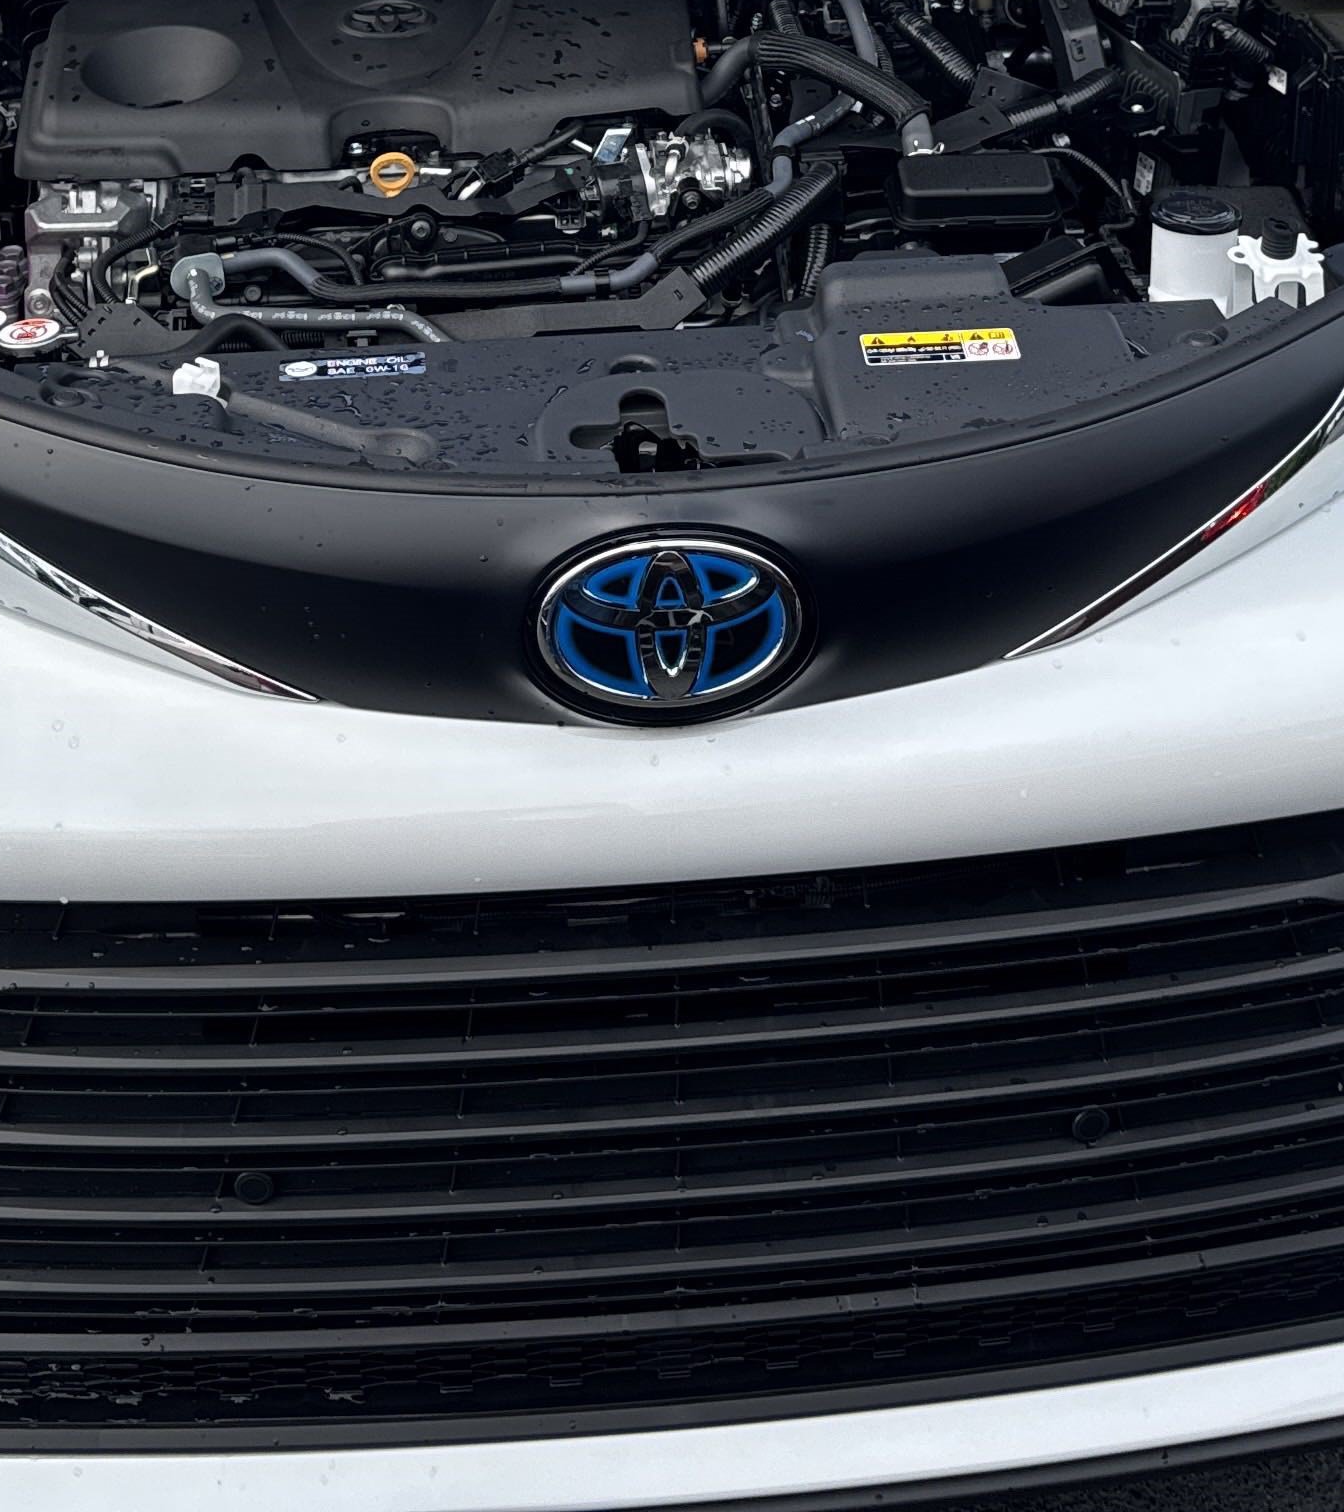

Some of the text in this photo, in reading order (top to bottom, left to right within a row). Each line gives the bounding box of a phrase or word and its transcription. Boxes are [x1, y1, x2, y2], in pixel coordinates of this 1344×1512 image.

[327, 355, 406, 367] ENGINE OIL
[327, 363, 409, 375] SAE 0W-16
